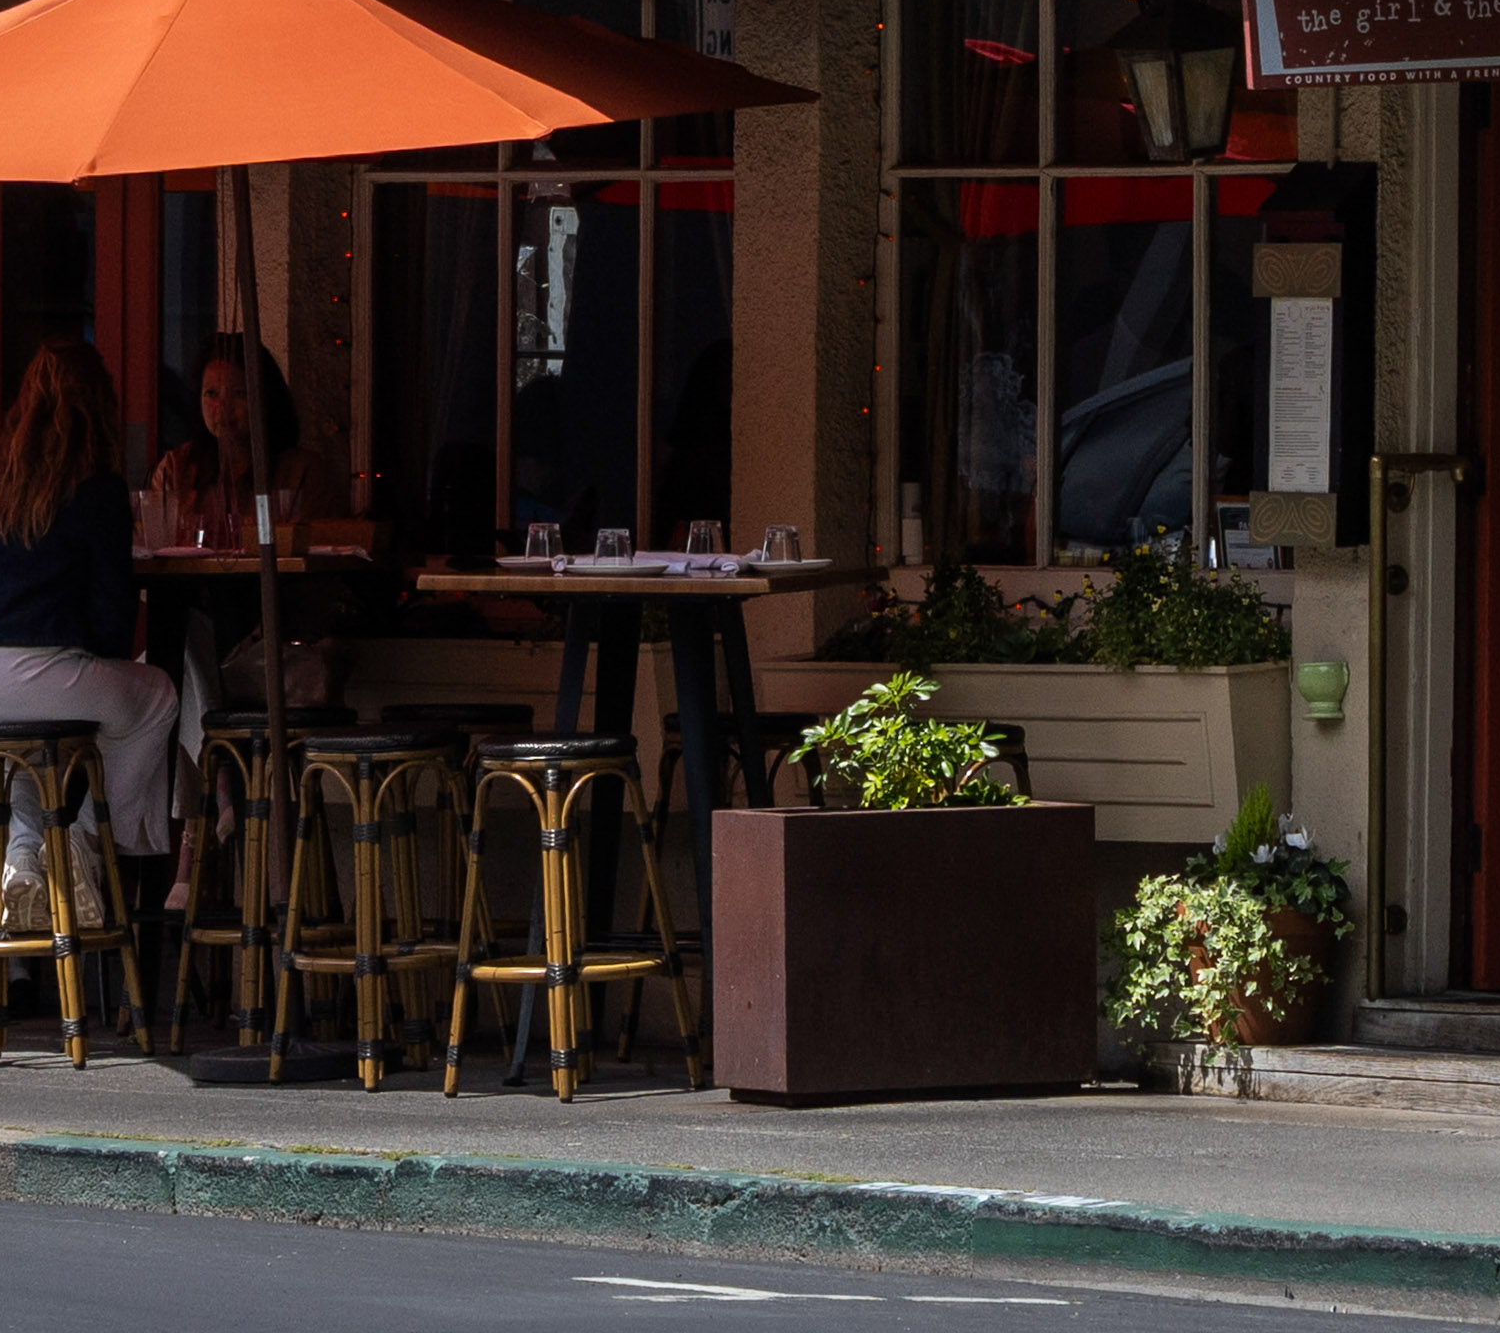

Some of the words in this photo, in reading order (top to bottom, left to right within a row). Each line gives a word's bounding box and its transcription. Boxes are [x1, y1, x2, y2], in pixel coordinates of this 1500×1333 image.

[1297, 8, 1342, 33] the
[1285, 73, 1351, 85] COUNTRY
[1359, 72, 1397, 83] FOOD
[1405, 70, 1442, 81] WITH
[1450, 70, 1459, 79] A
